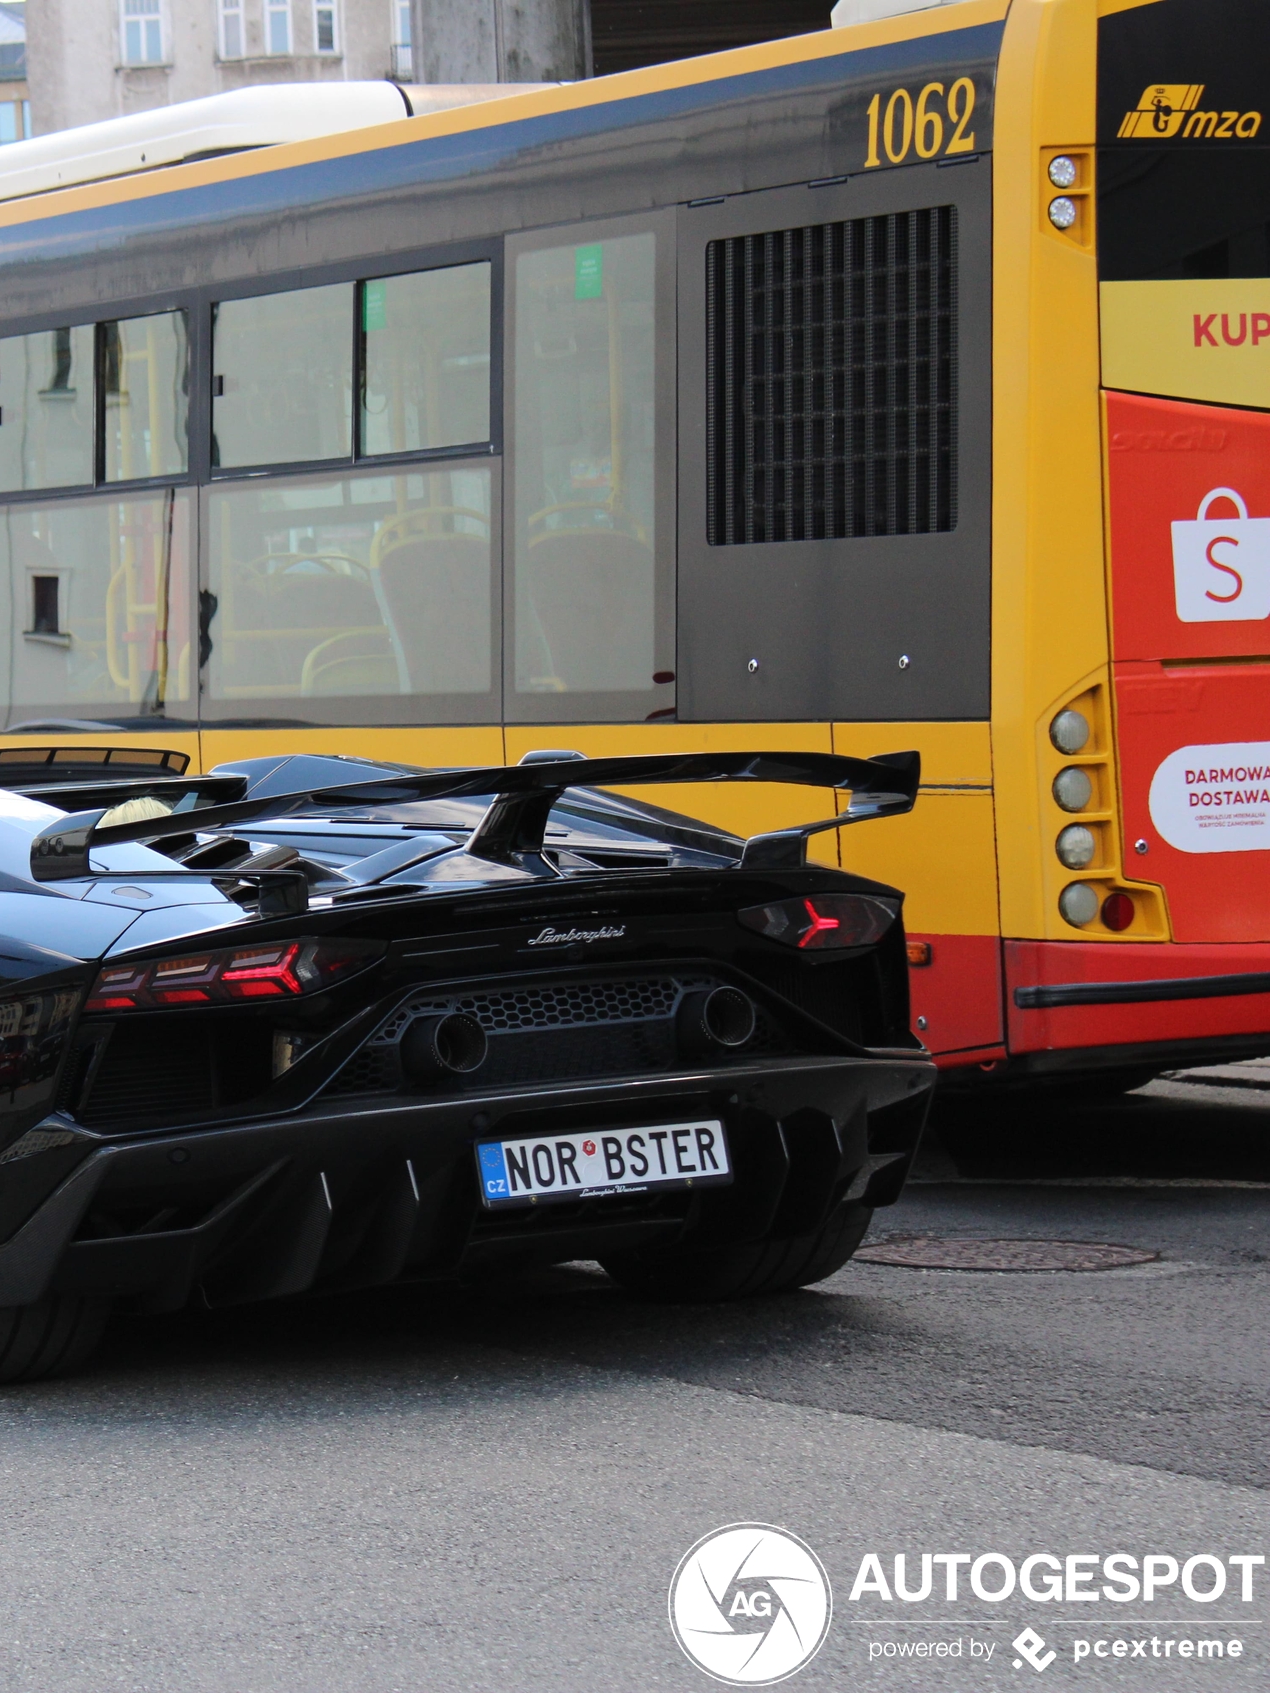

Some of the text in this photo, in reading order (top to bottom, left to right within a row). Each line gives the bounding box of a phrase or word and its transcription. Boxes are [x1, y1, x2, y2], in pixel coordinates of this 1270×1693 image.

[864, 77, 976, 168] 1062
[1182, 111, 1262, 138] mza
[1185, 766, 1270, 785] DARMOWA
[1189, 788, 1270, 807] DOSTAWA
[528, 925, 625, 945] Lamborghini
[505, 1127, 720, 1192] NOR BSTER
[487, 1179, 506, 1193] CZ
